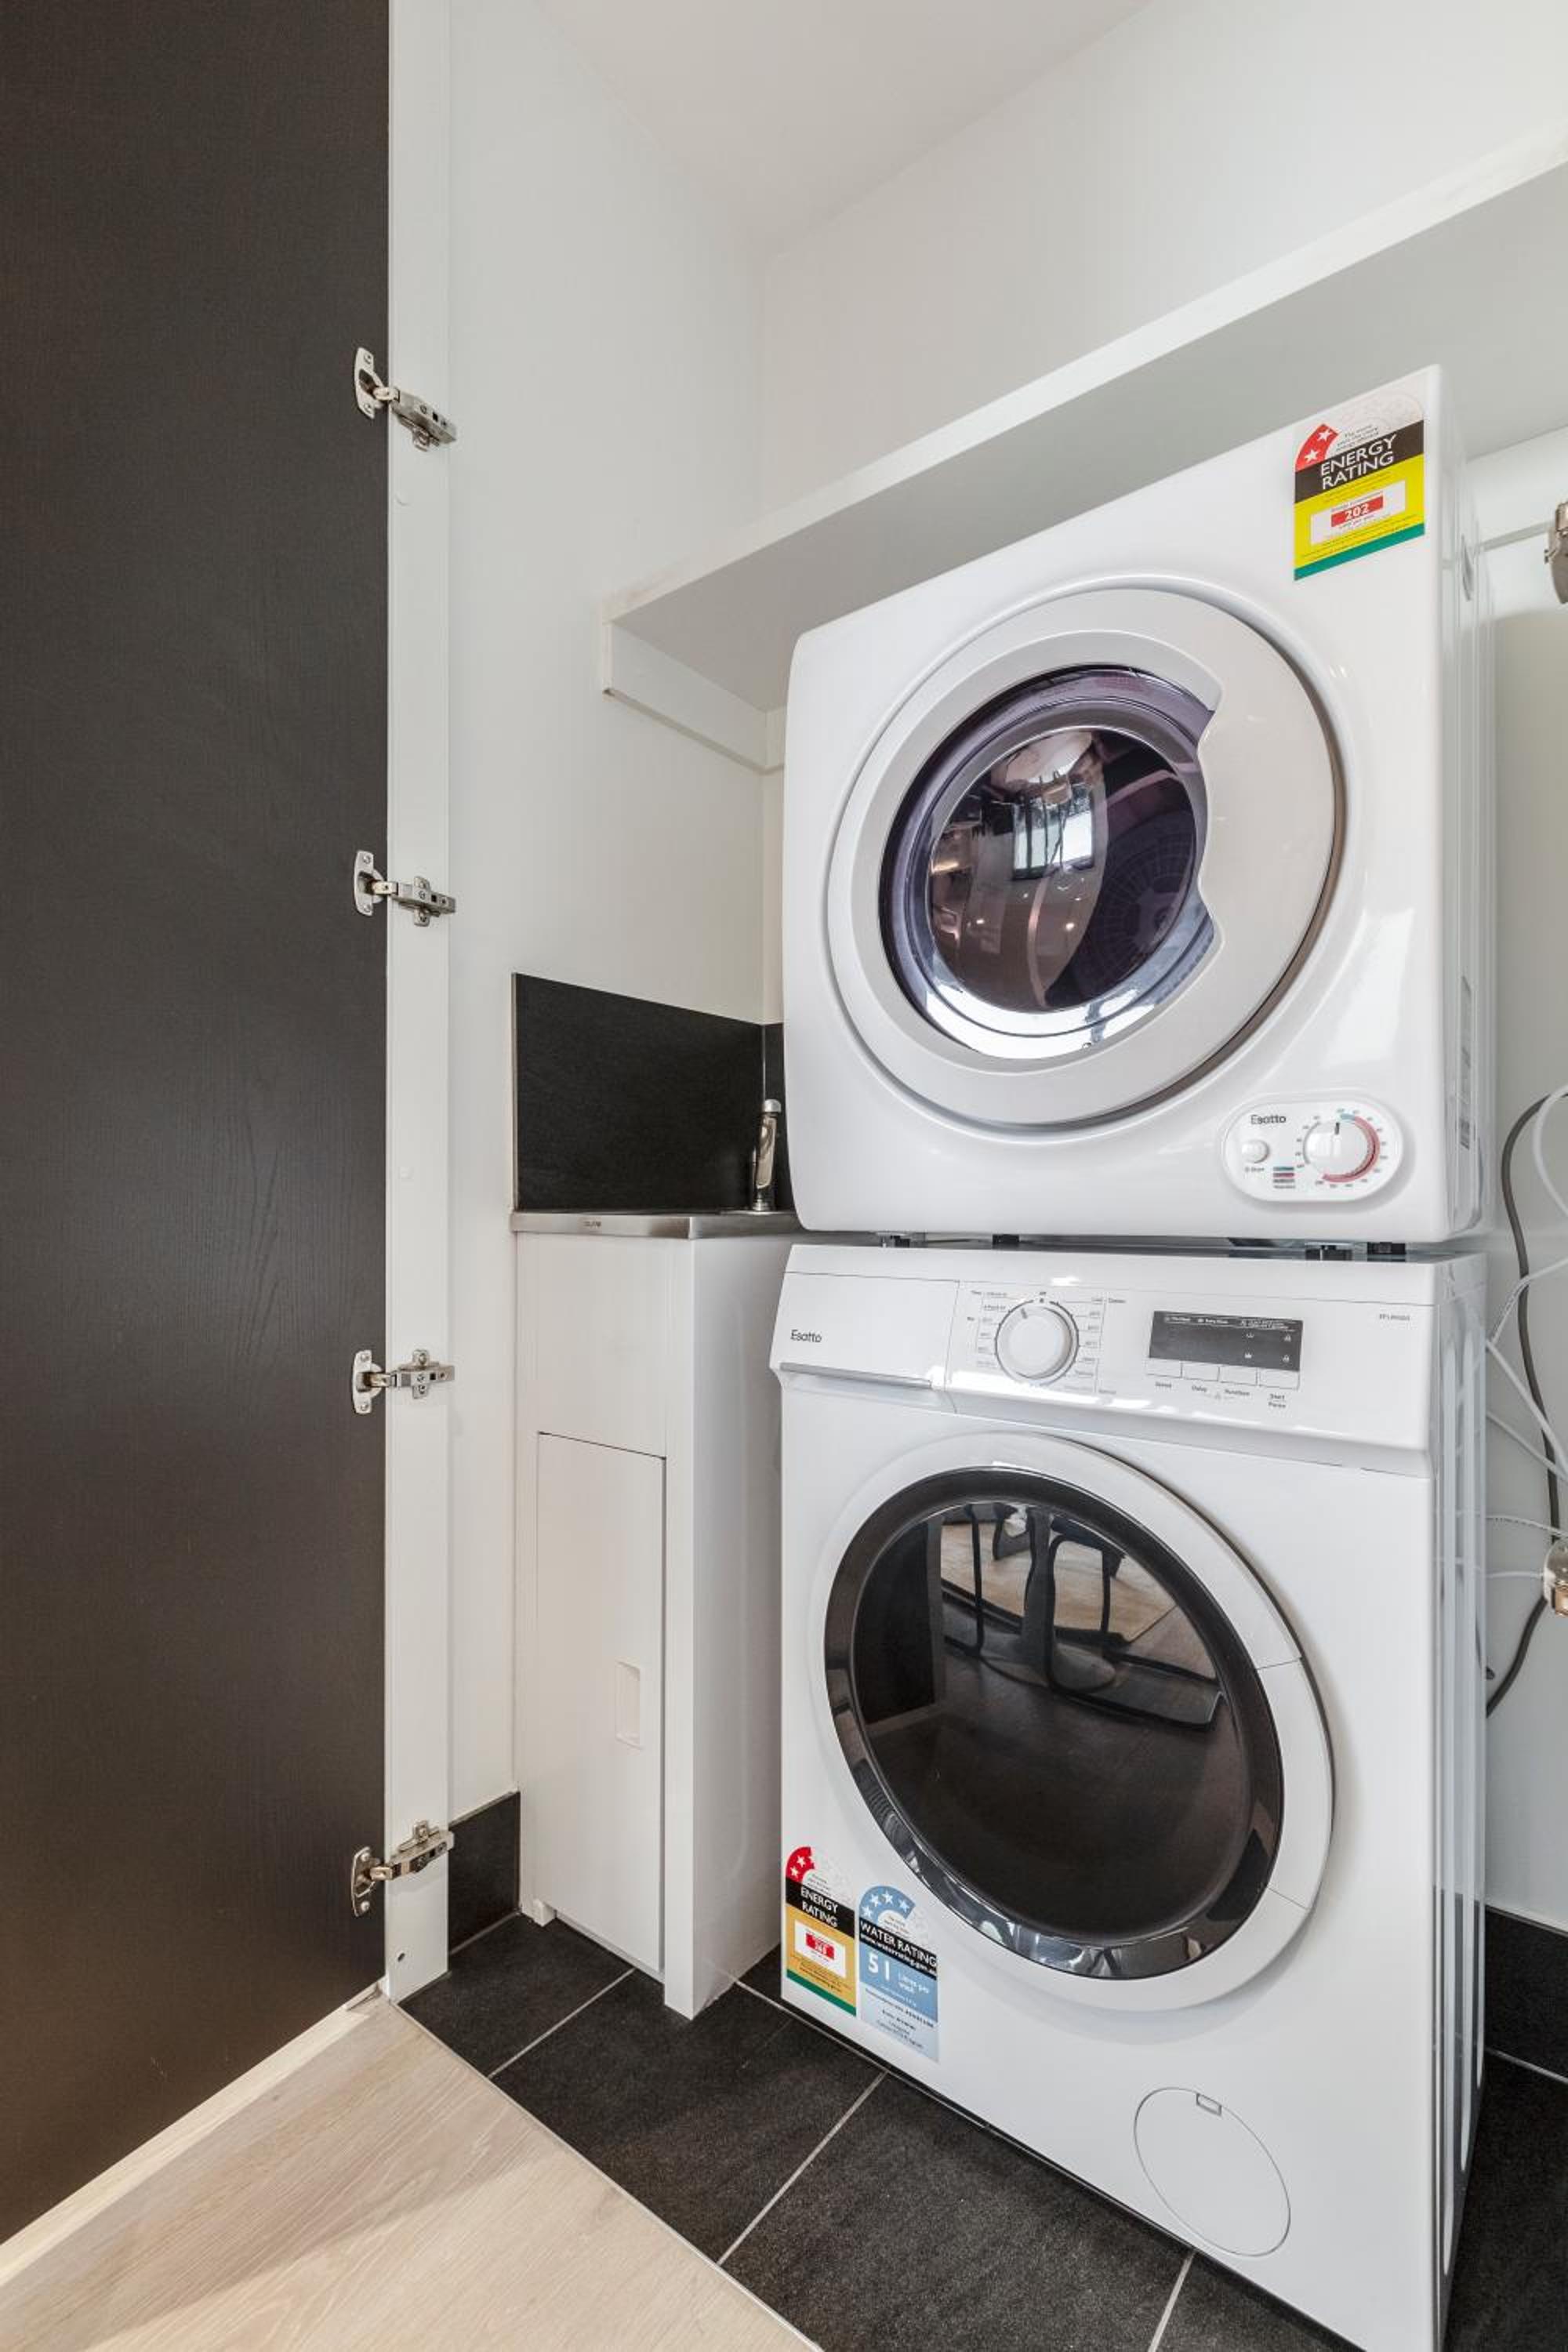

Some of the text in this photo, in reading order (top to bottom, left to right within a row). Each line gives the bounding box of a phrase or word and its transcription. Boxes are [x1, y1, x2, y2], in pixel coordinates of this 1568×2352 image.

[1321, 434, 1396, 476] ENERGY
[1323, 451, 1394, 490] RATING
[1345, 503, 1370, 521] 202
[1250, 1114, 1287, 1124] Esatto
[790, 1329, 822, 1343] Esatto
[800, 1886, 838, 1914] ENERGY
[802, 1900, 838, 1928] RATING
[860, 1920, 896, 1947] WATER
[897, 1939, 937, 1967] RATING
